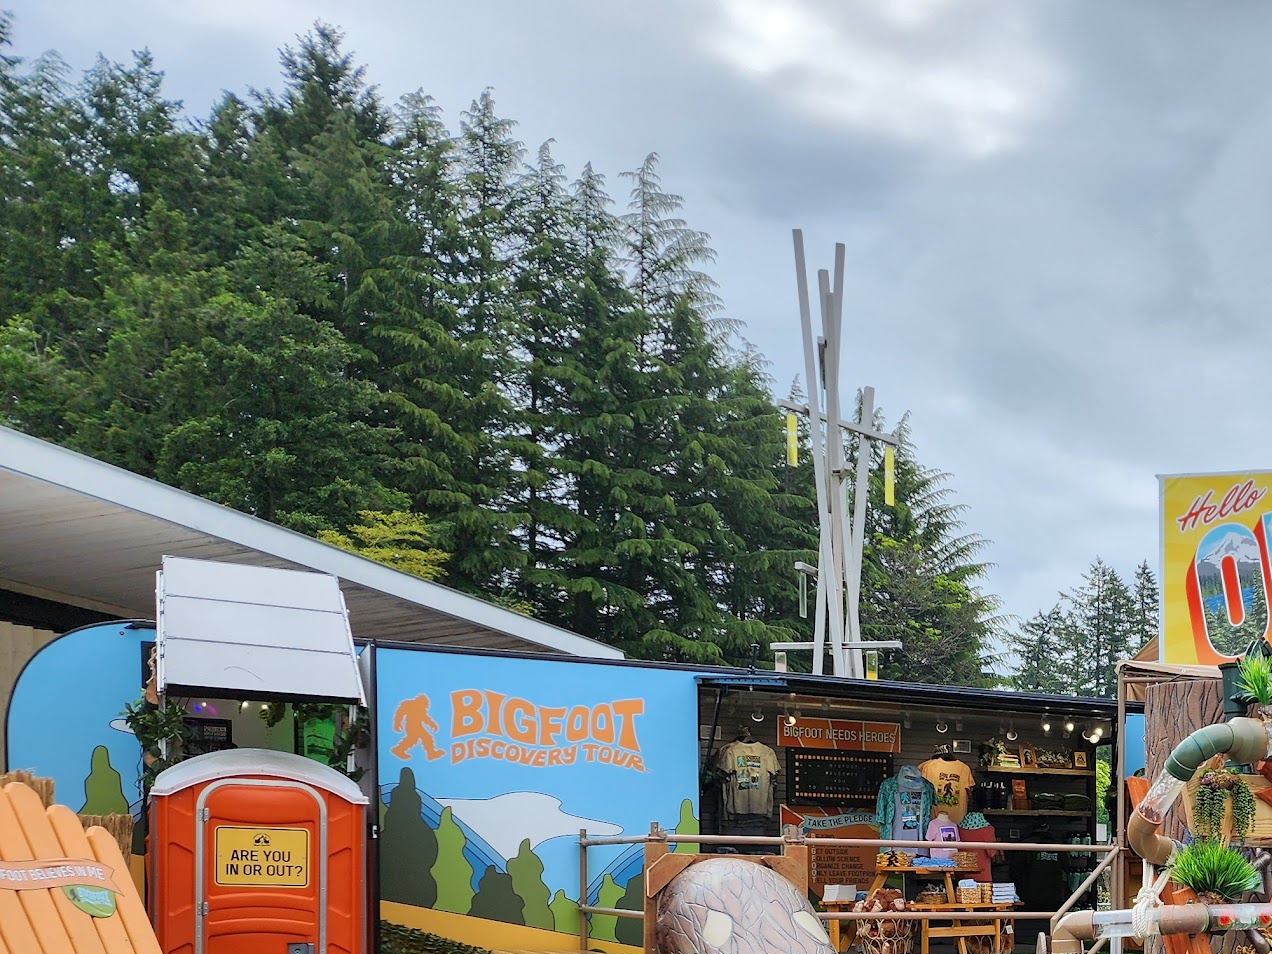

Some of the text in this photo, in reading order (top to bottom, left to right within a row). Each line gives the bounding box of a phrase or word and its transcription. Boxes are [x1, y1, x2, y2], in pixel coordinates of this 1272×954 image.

[1177, 479, 1267, 532] Hello
[450, 688, 645, 752] BIGFOOT
[783, 726, 896, 743] BIGFOOT NEEDS HEROES
[450, 737, 645, 773] DISCOVERY TOUR
[808, 815, 873, 828] TAKE THE PLEDGE
[230, 849, 291, 862] ARE YOU
[29, 866, 75, 881] BELIEVES
[75, 866, 88, 877] IN
[88, 866, 105, 880] ME
[226, 863, 303, 877] IN OR OUT?
[811, 876, 827, 884] TELL
